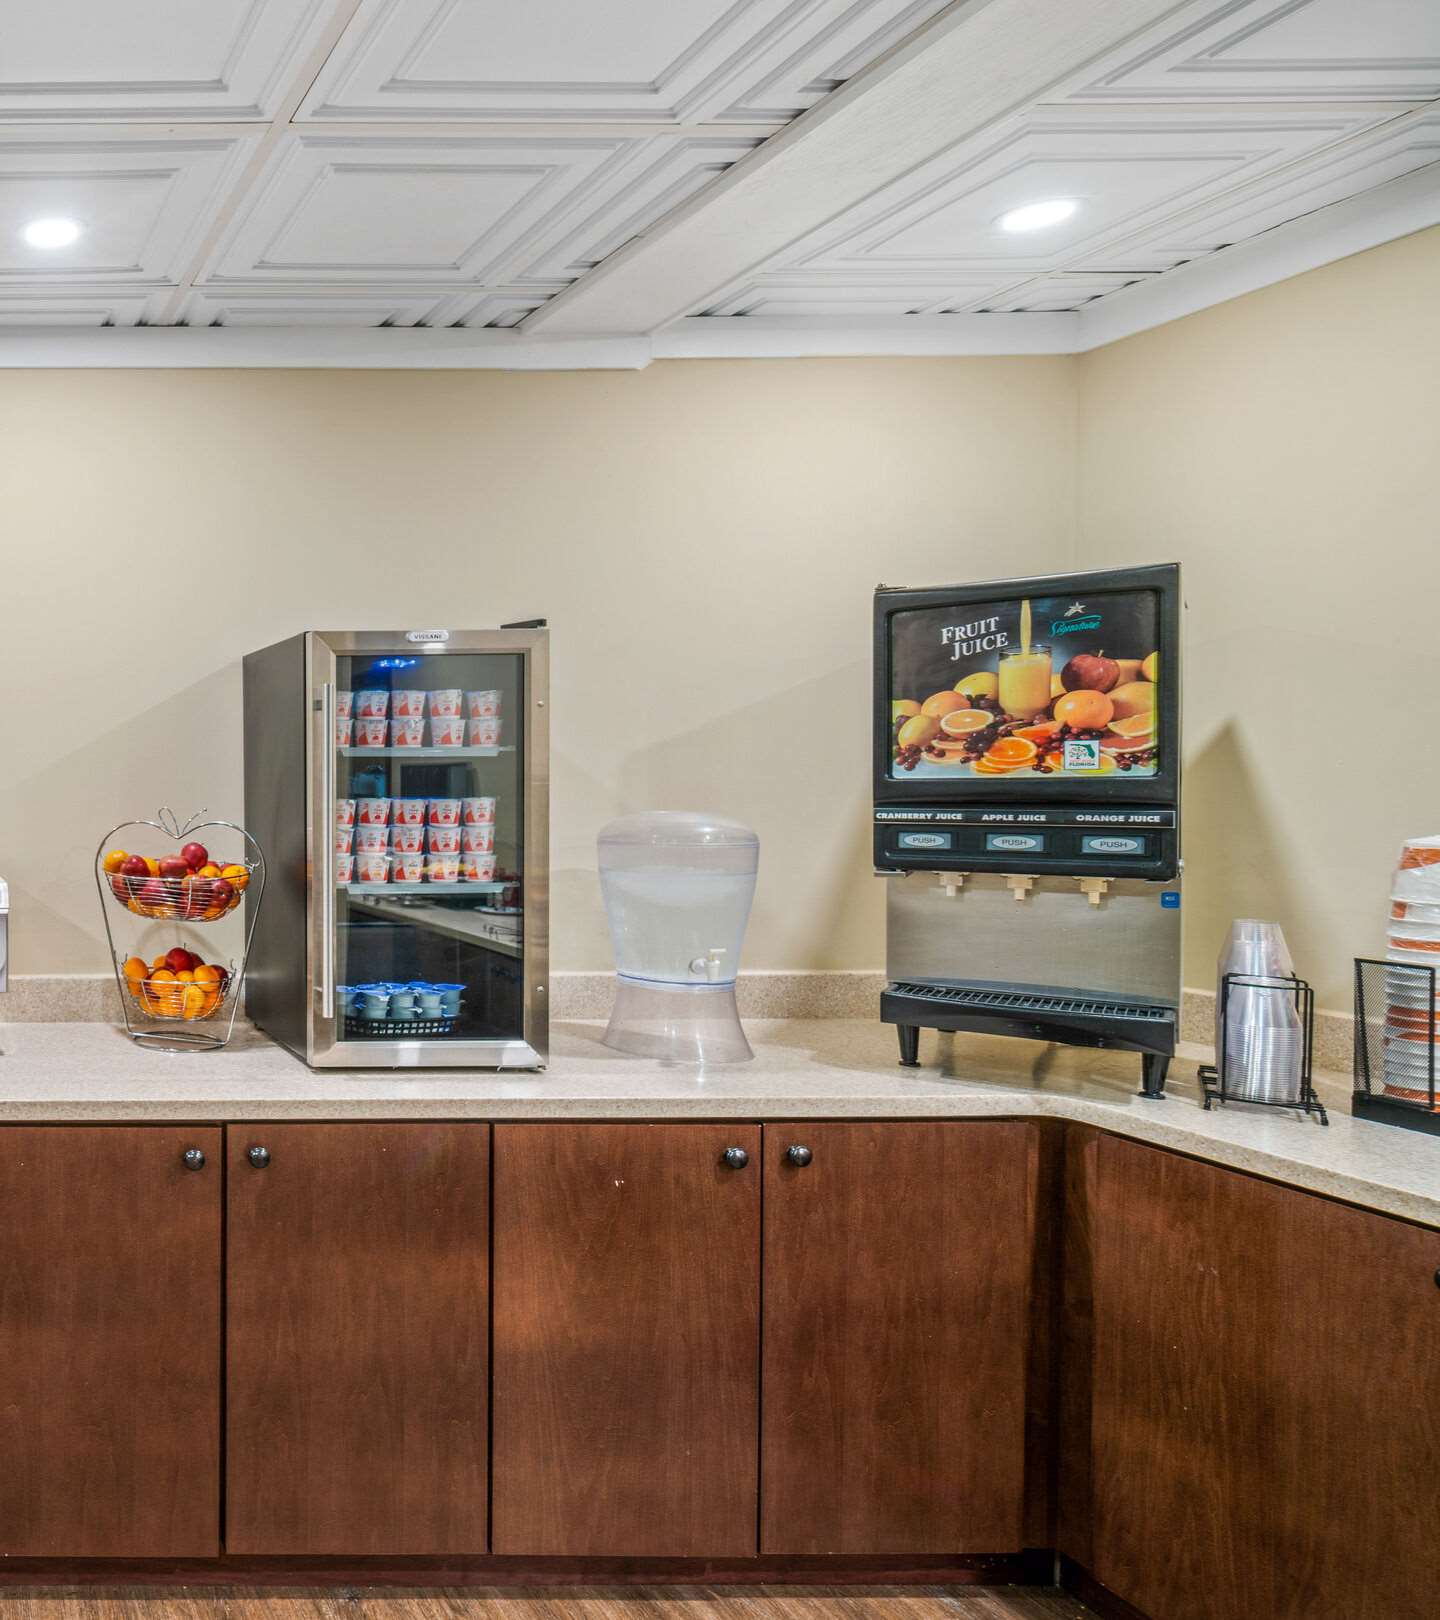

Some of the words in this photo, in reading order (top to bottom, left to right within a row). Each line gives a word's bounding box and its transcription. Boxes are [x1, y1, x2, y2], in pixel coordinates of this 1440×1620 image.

[941, 616, 1000, 645] FRUIT
[951, 632, 1009, 661] JUICE
[875, 812, 933, 821] CRANBERRY
[935, 812, 963, 821] JUICE
[981, 813, 1014, 822] APPLE
[1016, 814, 1047, 822] JUICE
[1076, 814, 1125, 823] ORANGE
[1128, 815, 1161, 823] JUICE
[912, 836, 936, 844] PUSH
[1001, 838, 1028, 847] PUSH
[1099, 840, 1128, 849] PUSH
